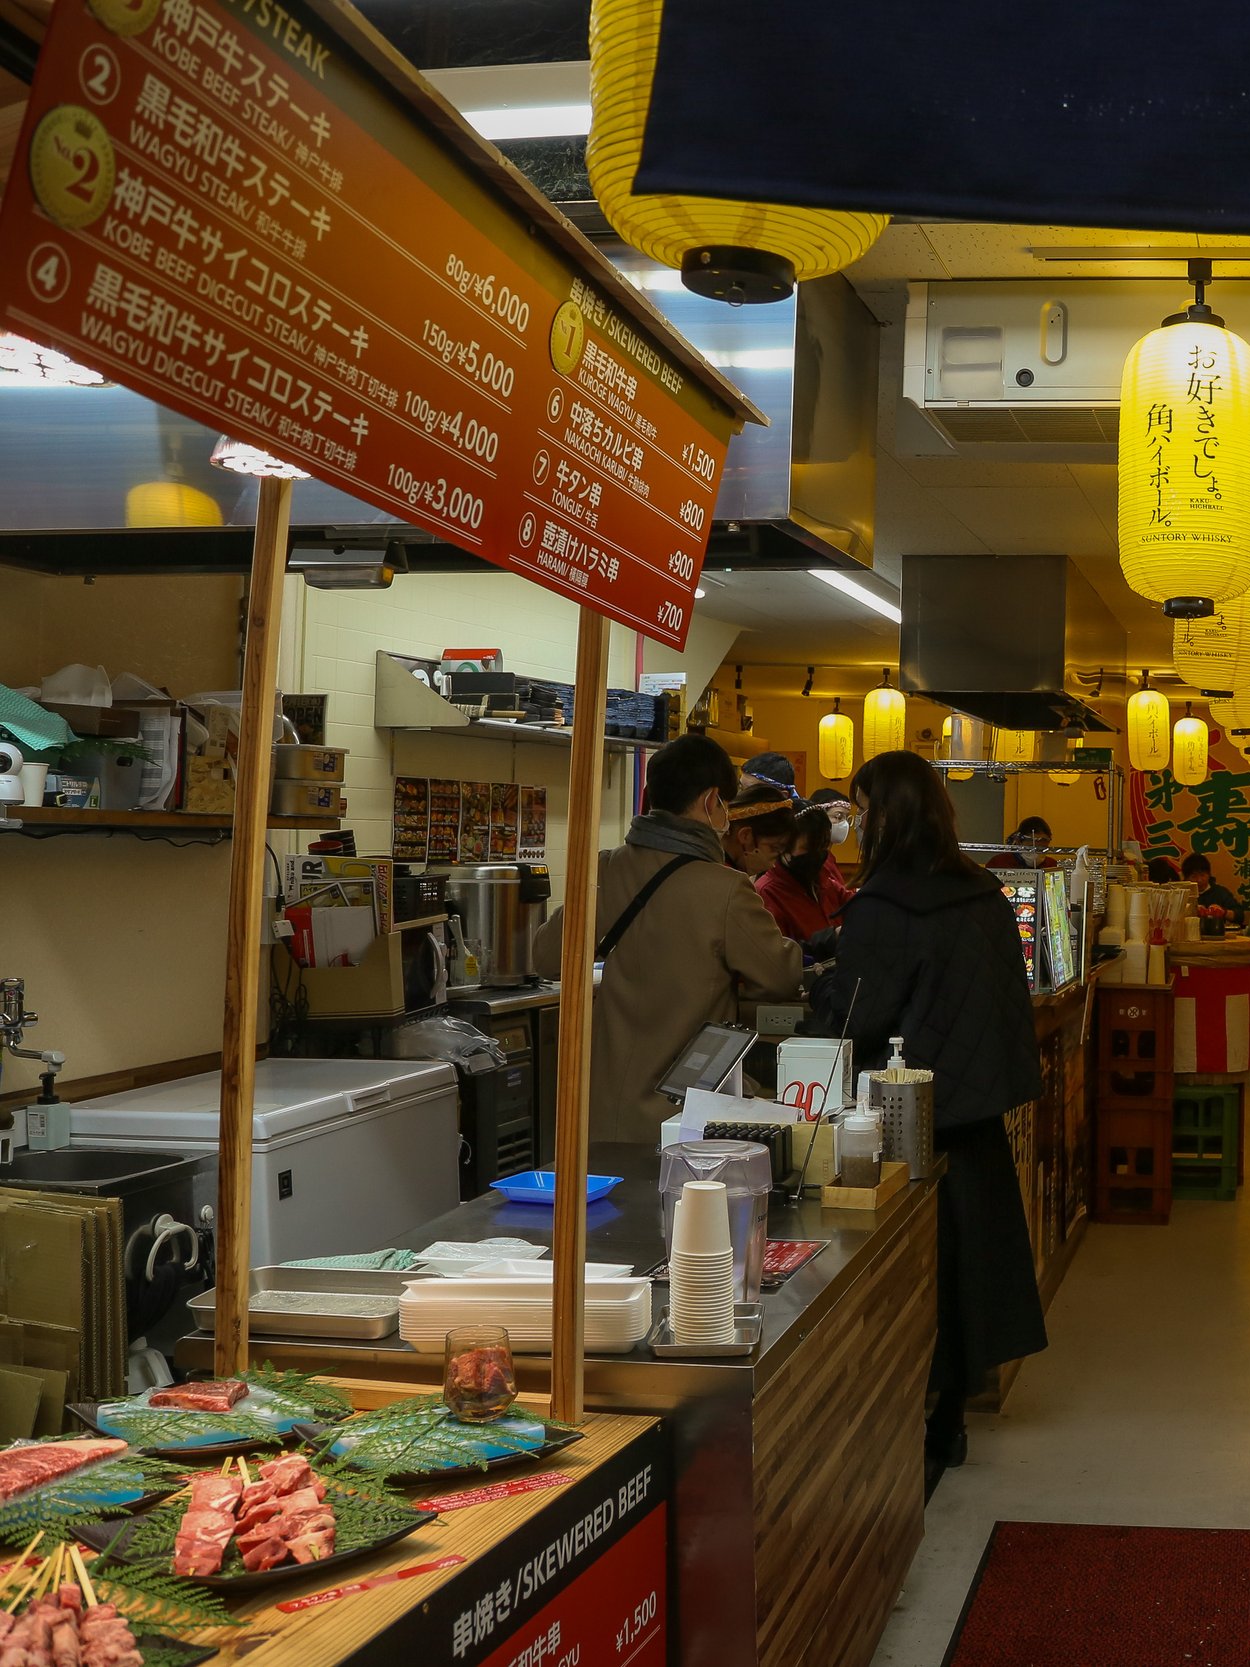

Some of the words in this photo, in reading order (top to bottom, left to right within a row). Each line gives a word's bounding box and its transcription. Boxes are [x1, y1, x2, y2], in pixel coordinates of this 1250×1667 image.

[152, 26, 200, 80] KOBE
[202, 66, 243, 109] BEEF
[162, 0, 332, 149] 神戸牛ステーキ
[128, 120, 199, 185] WAGYU
[135, 73, 332, 242] 黒毛和牛ステーキ
[102, 214, 155, 263] KOBE
[154, 246, 197, 284] BEEF
[196, 270, 264, 327] DICECUT
[114, 167, 370, 360] 神戸牛サイコロステーキ
[80, 310, 154, 367] WAGYU
[152, 349, 226, 402] DICECUT
[85, 263, 370, 447] 黒毛和牛サイコロステーキ
[577, 367, 607, 401] KUROGE
[581, 338, 639, 403] 黒毛和牛串
[660, 362, 684, 395] BEEF
[563, 427, 603, 464] NAKAOCHI
[569, 400, 645, 473] 中落ちカルビ串
[1186, 345, 1223, 501] お好きでしょ。
[556, 458, 603, 510] 牛タン串
[682, 441, 716, 483] ¥1,500
[1145, 403, 1174, 528] 角ハイボール。
[679, 498, 706, 532] ¥800
[1141, 533, 1188, 544] SUNTORY
[1190, 532, 1234, 544] WHISKY
[1189, 503, 1225, 511] HIGHBALL
[667, 548, 695, 583] ¥900
[656, 600, 684, 633] ¥700
[618, 1463, 652, 1521] BEEF
[615, 1590, 658, 1653] ¥1,500
